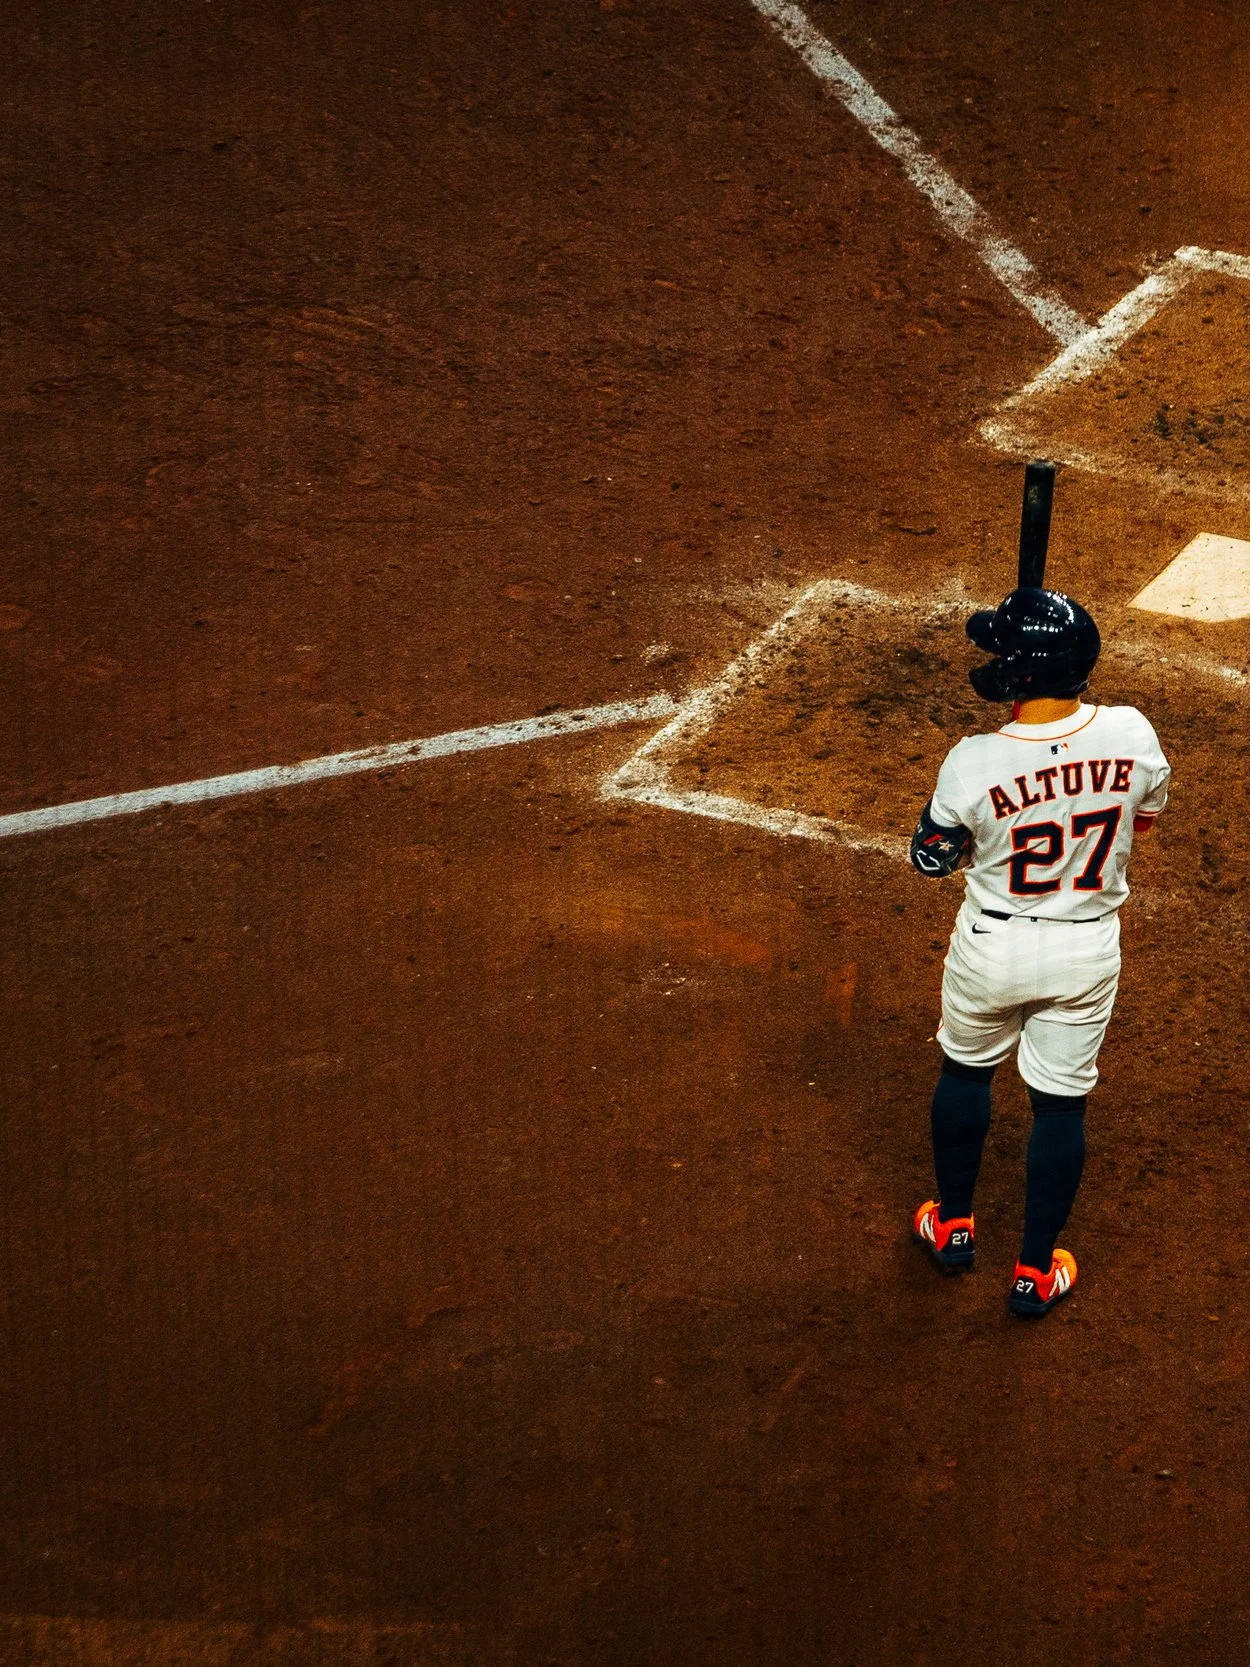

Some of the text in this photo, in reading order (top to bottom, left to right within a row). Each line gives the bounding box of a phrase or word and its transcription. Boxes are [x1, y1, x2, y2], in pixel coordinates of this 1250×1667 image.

[988, 759, 1135, 820] ALTUVE
[1008, 805, 1122, 895] 27
[952, 1231, 969, 1245] 27
[1016, 1279, 1034, 1293] 27
